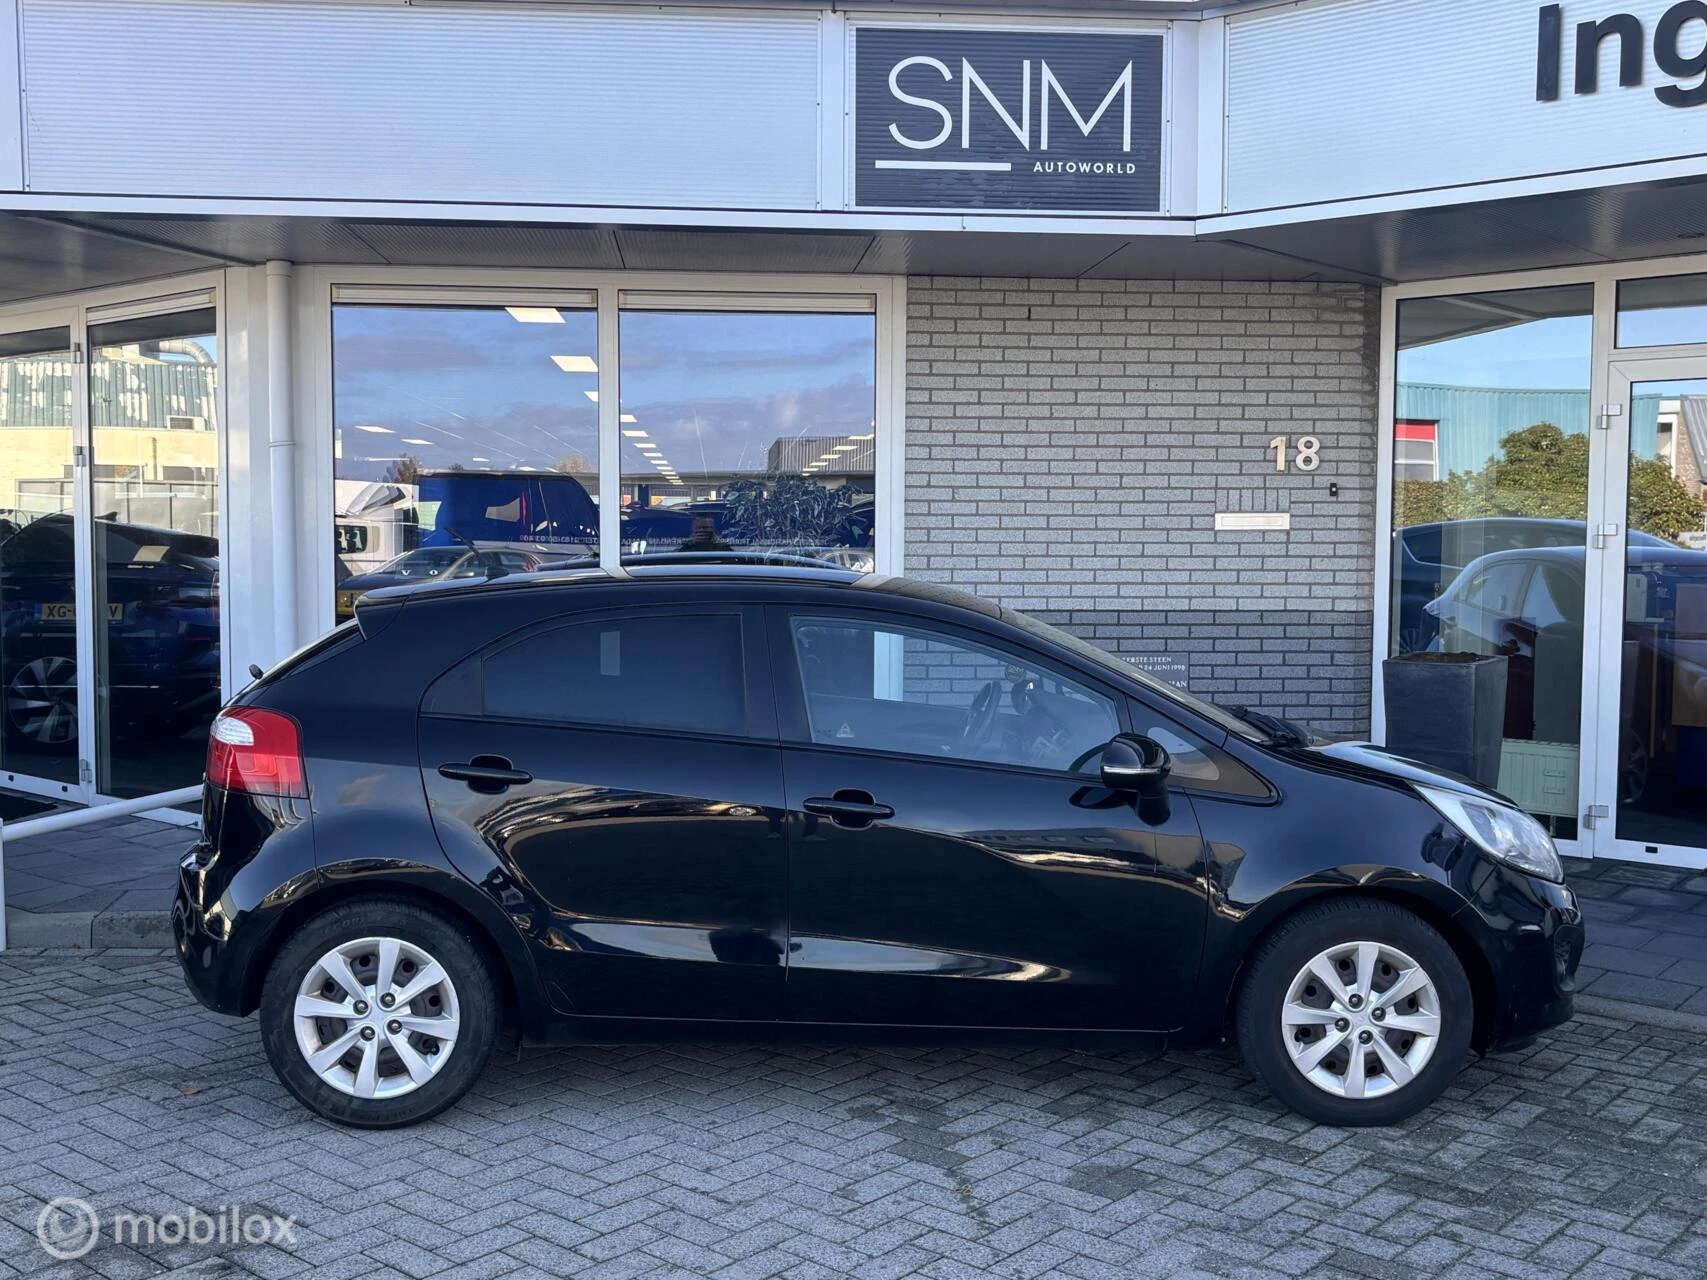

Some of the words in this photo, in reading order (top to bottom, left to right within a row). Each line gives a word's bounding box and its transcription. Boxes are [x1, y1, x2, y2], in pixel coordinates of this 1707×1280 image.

[1536, 0, 1707, 108] Ing
[888, 55, 1133, 151] SNM
[1033, 161, 1136, 174] AUTOWORLD
[1270, 436, 1320, 472] 18
